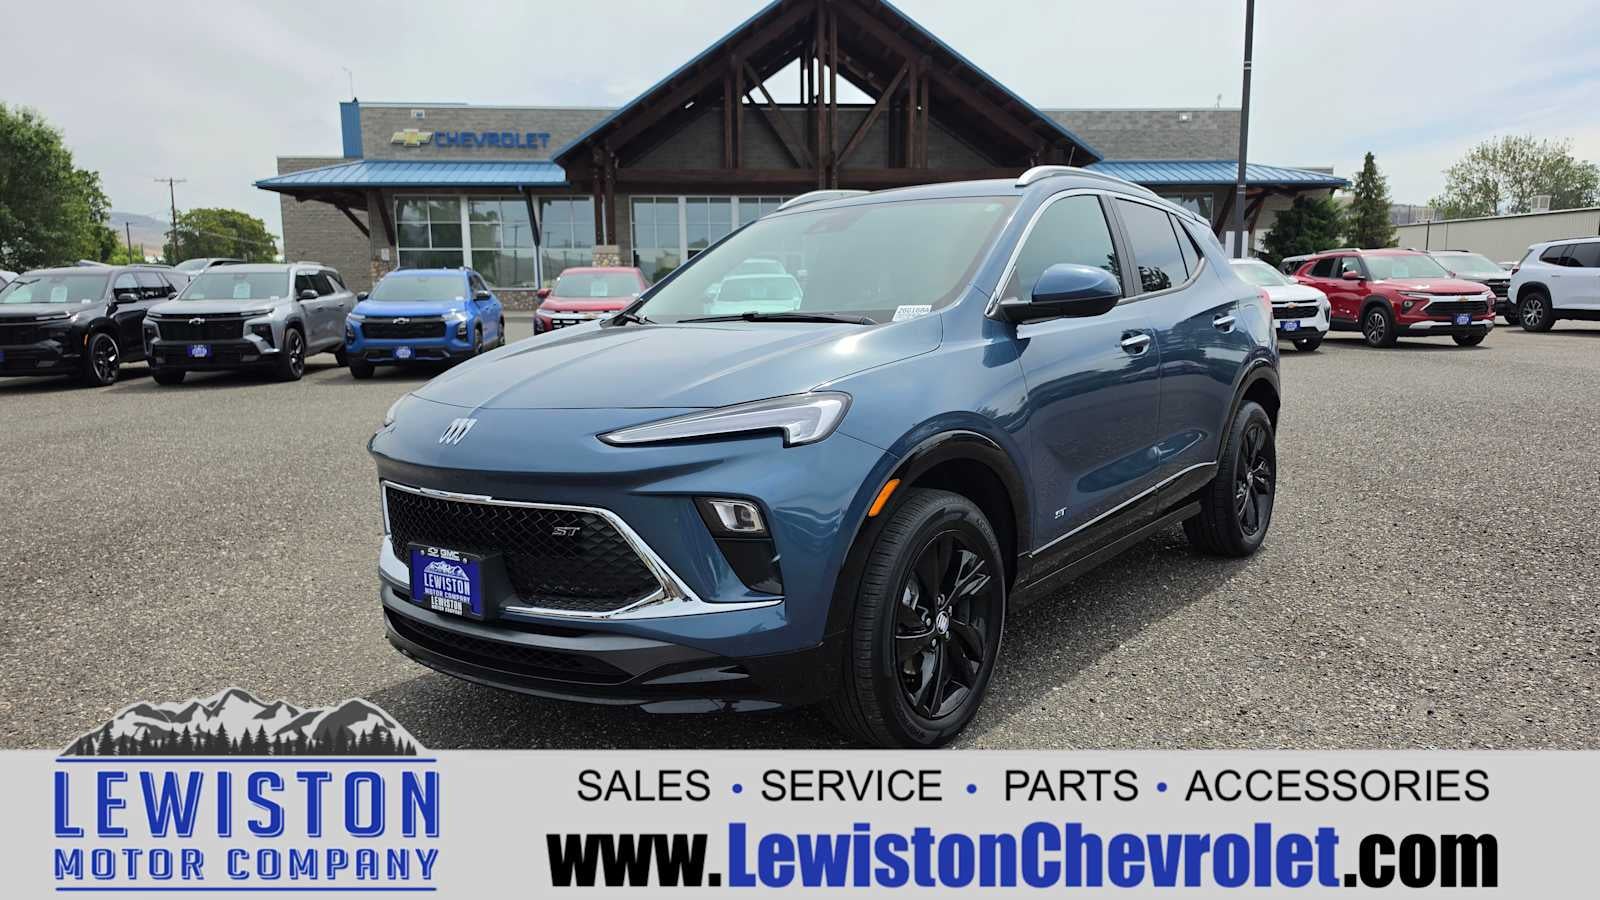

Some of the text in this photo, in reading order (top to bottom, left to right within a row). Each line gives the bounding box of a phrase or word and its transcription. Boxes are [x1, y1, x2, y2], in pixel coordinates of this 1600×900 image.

[434, 131, 550, 148] CHEVROLET
[552, 526, 580, 536] ST
[440, 548, 460, 560] GMC
[424, 572, 470, 596] LEWISTON
[424, 587, 470, 604] MOTOR COMPANY
[431, 595, 463, 610] LEWISTON
